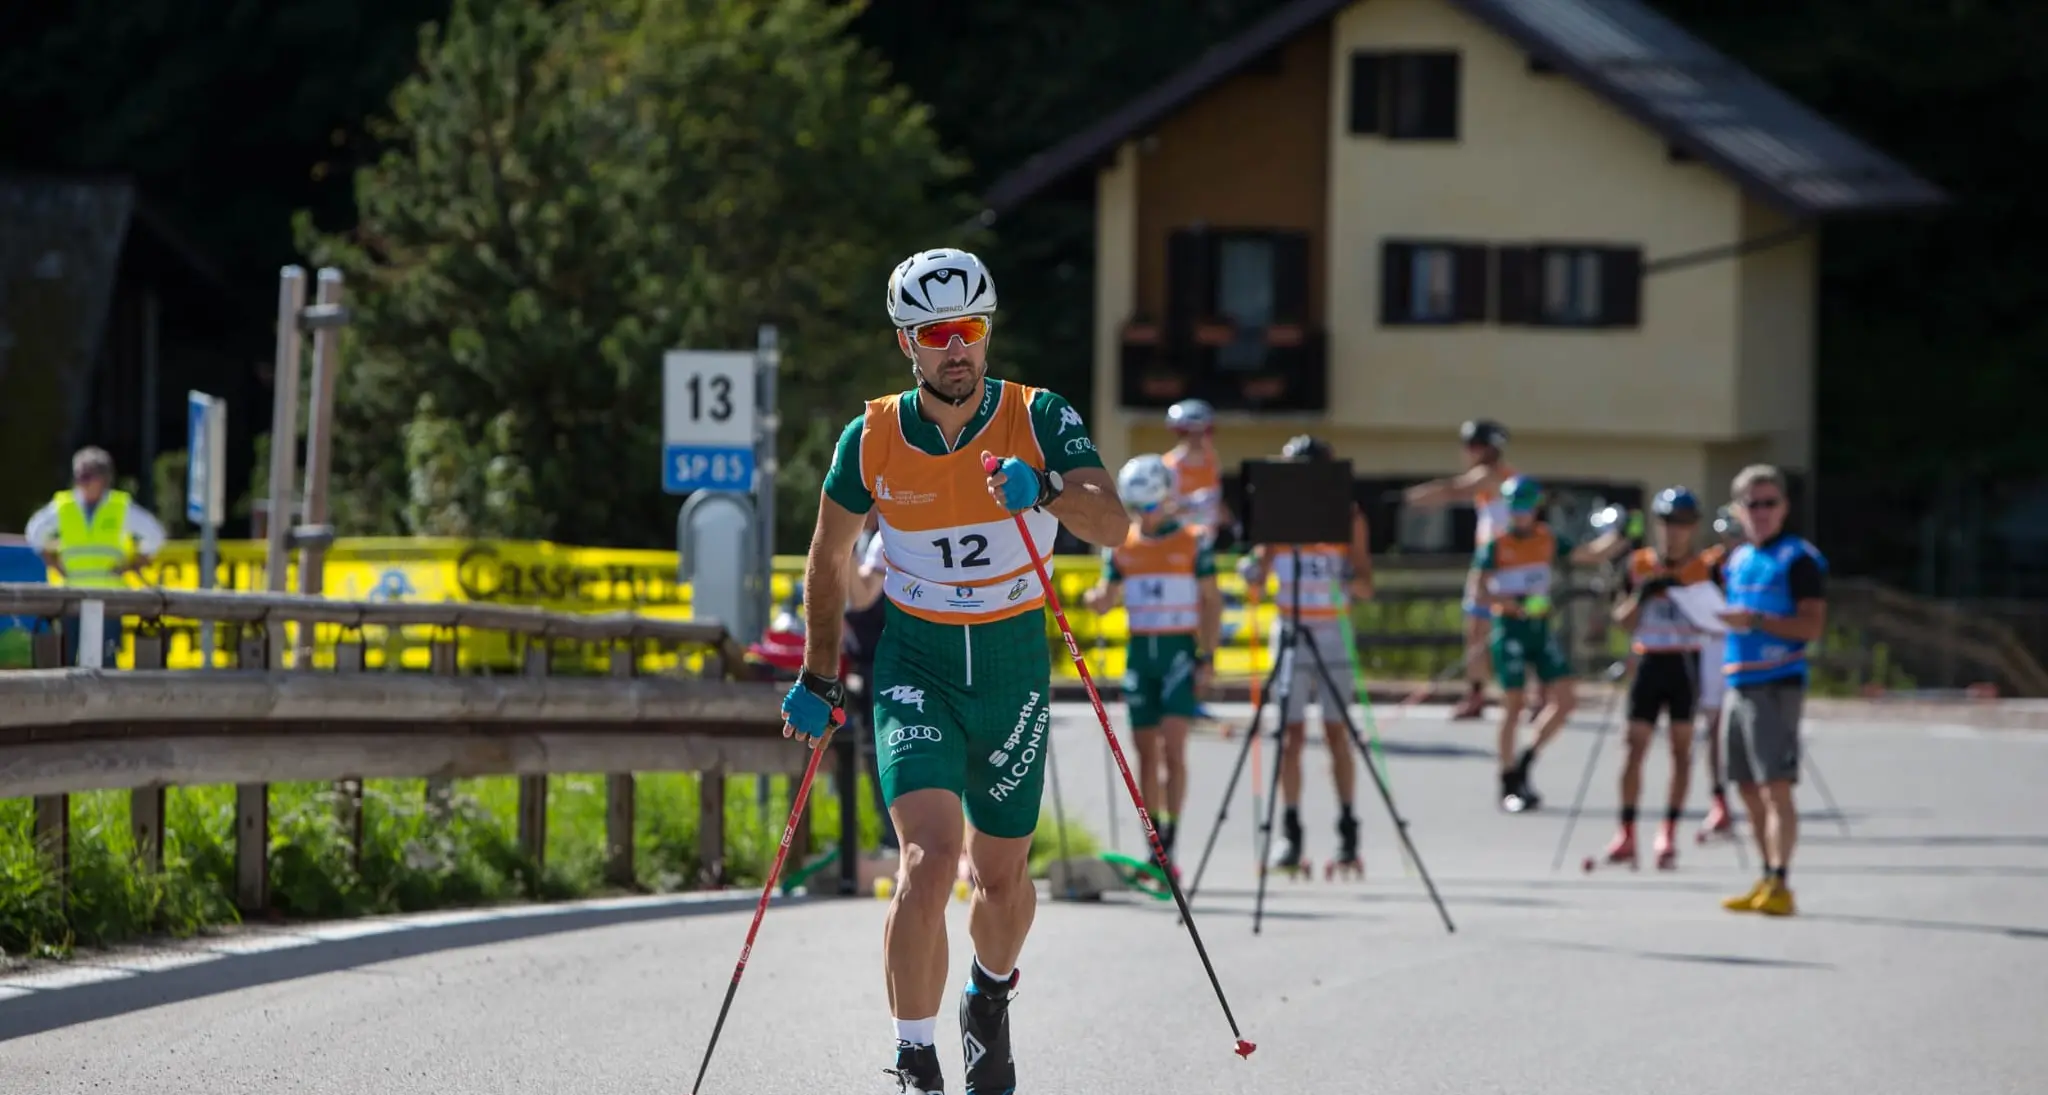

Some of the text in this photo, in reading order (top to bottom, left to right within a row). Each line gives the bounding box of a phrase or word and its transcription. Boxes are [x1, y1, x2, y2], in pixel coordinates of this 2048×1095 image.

[686, 372, 733, 424] 13
[931, 534, 991, 568] 12
[1003, 691, 1040, 750] sportful
[890, 743, 913, 756] Audi
